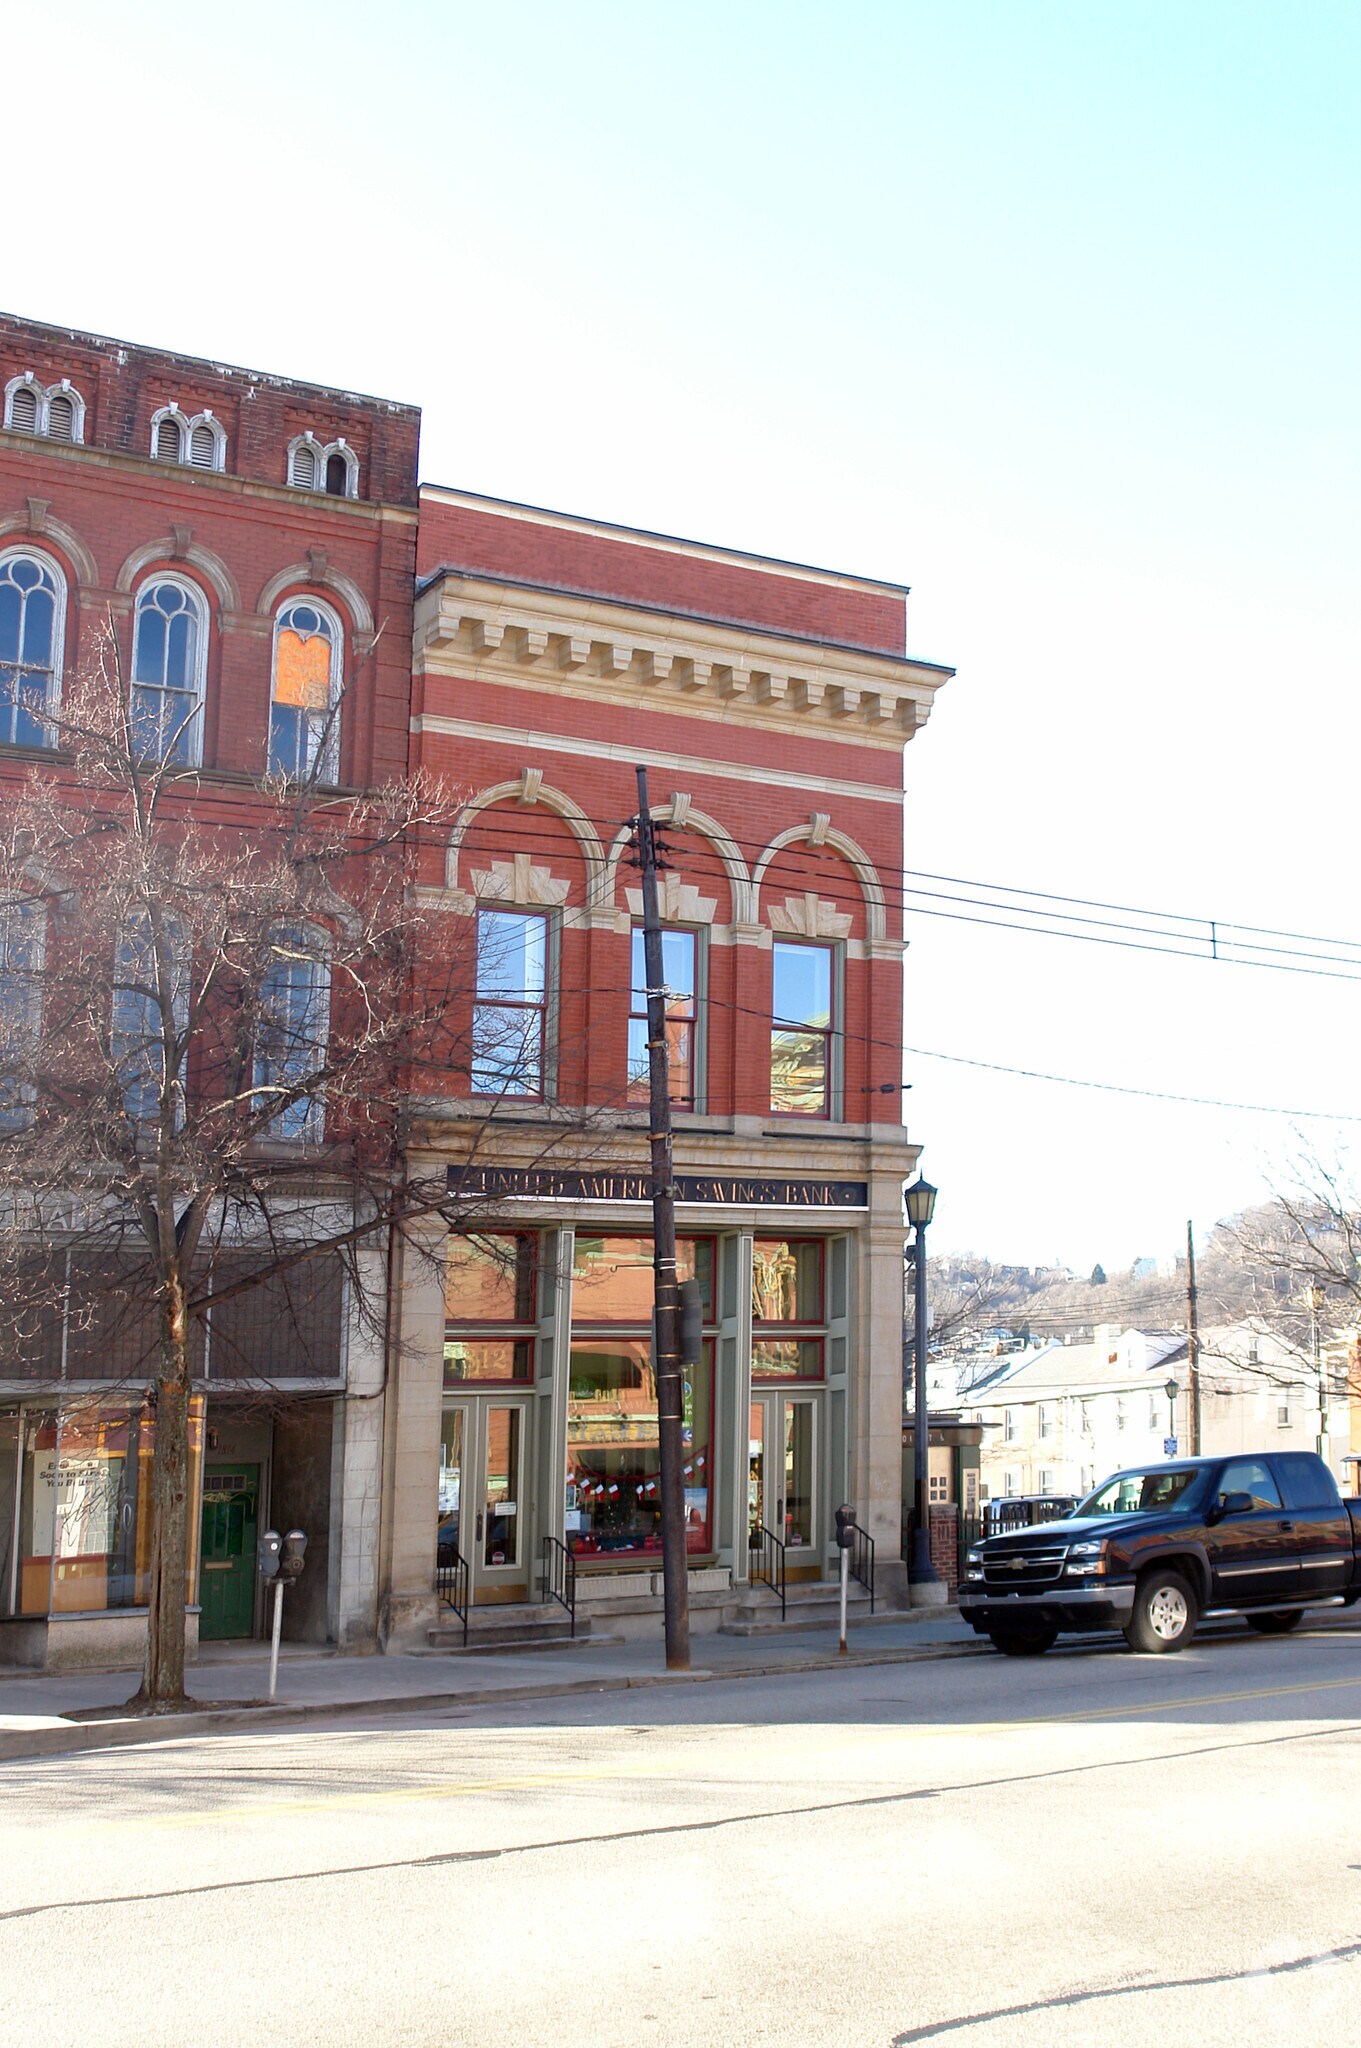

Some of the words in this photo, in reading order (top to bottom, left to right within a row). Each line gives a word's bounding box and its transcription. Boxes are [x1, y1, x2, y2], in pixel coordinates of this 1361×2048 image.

[481, 1172, 565, 1196] UNITED
[575, 1178, 686, 1200] AMERICN
[696, 1182, 776, 1203] SAVINGS
[785, 1185, 836, 1205] BANK
